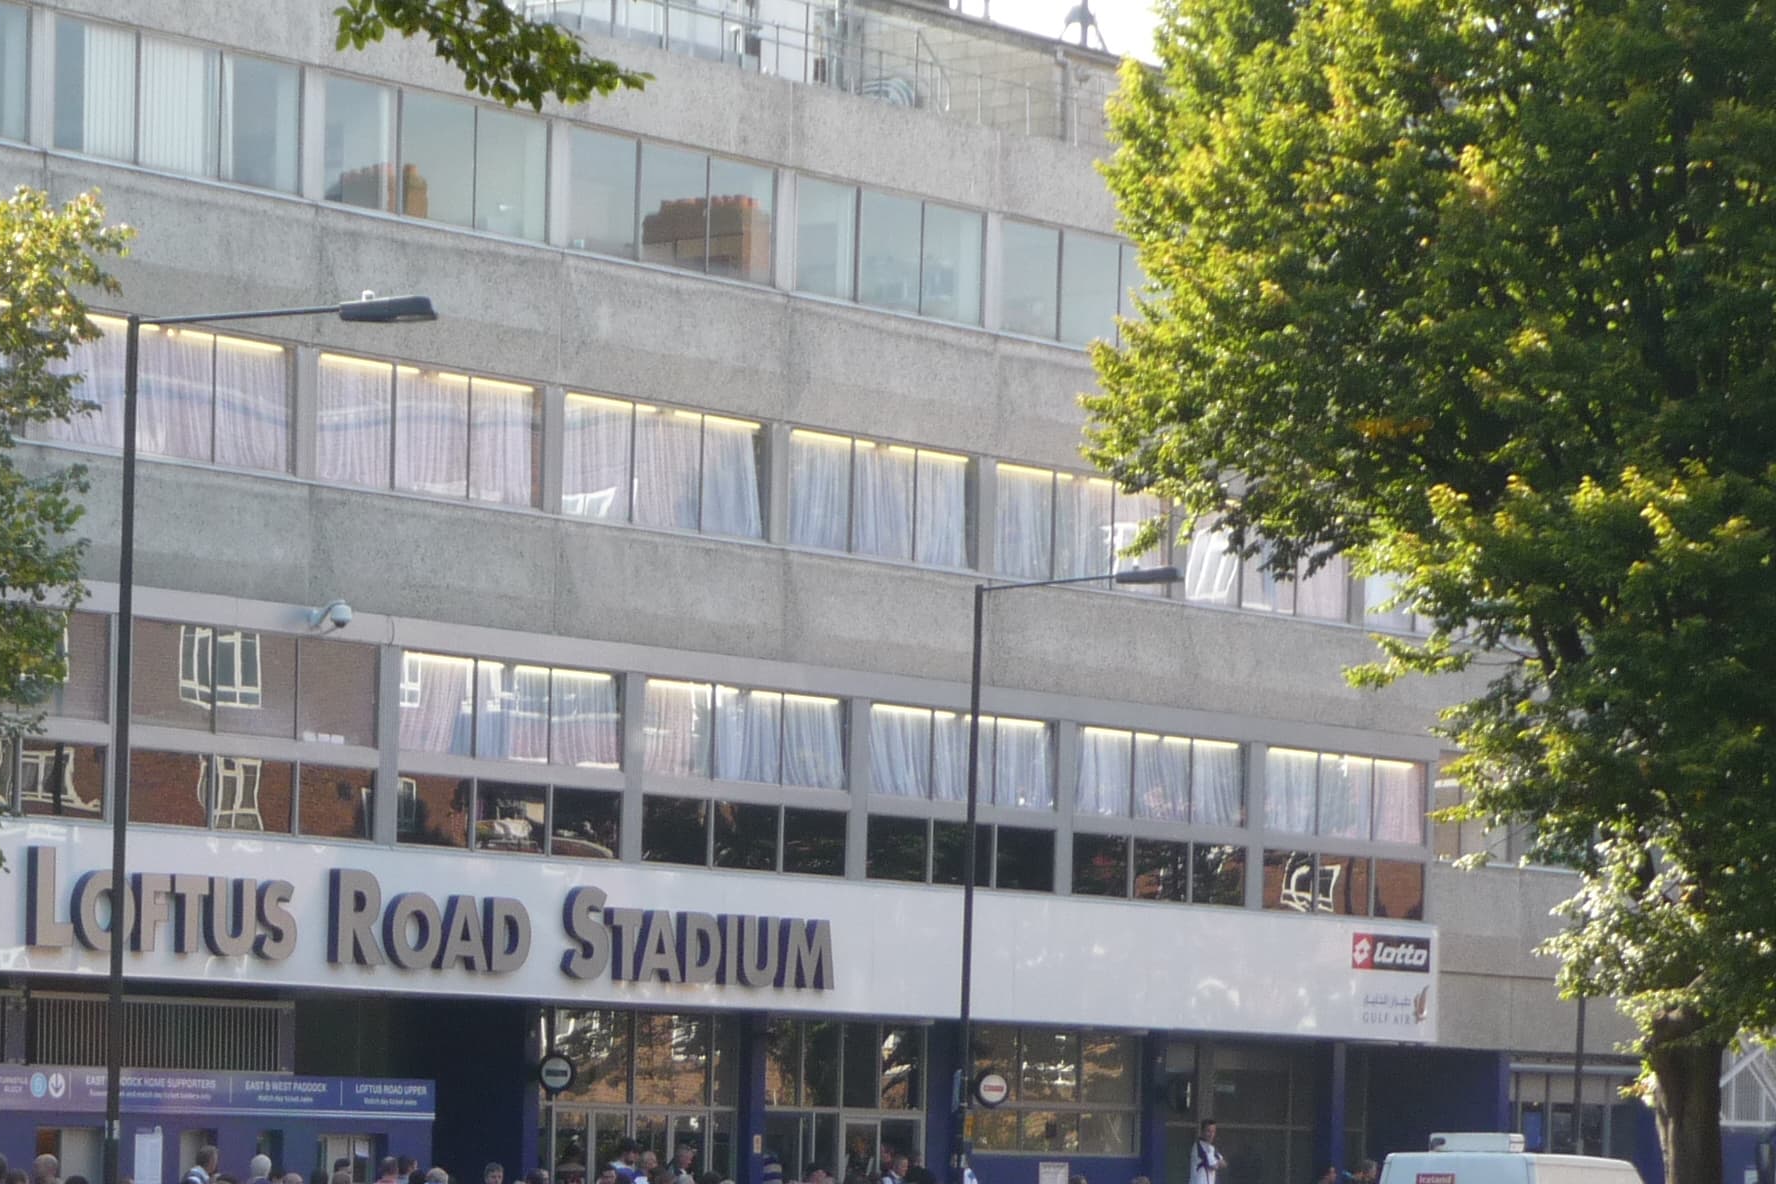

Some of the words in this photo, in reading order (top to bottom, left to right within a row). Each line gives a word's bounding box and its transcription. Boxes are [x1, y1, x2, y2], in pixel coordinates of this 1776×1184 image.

[25, 845, 298, 961] LOFTUS
[326, 867, 532, 973] ROAD
[560, 885, 835, 991] STADIUM
[1373, 942, 1428, 966] lotto
[86, 1075, 105, 1086] EAST
[167, 1077, 217, 1089] SUPPORTERS
[245, 1080, 264, 1091] EAST
[293, 1082, 327, 1093] PADDOCK
[355, 1083, 382, 1094] LOFTUS
[383, 1084, 403, 1095] ROAD
[404, 1085, 427, 1096] UPPER
